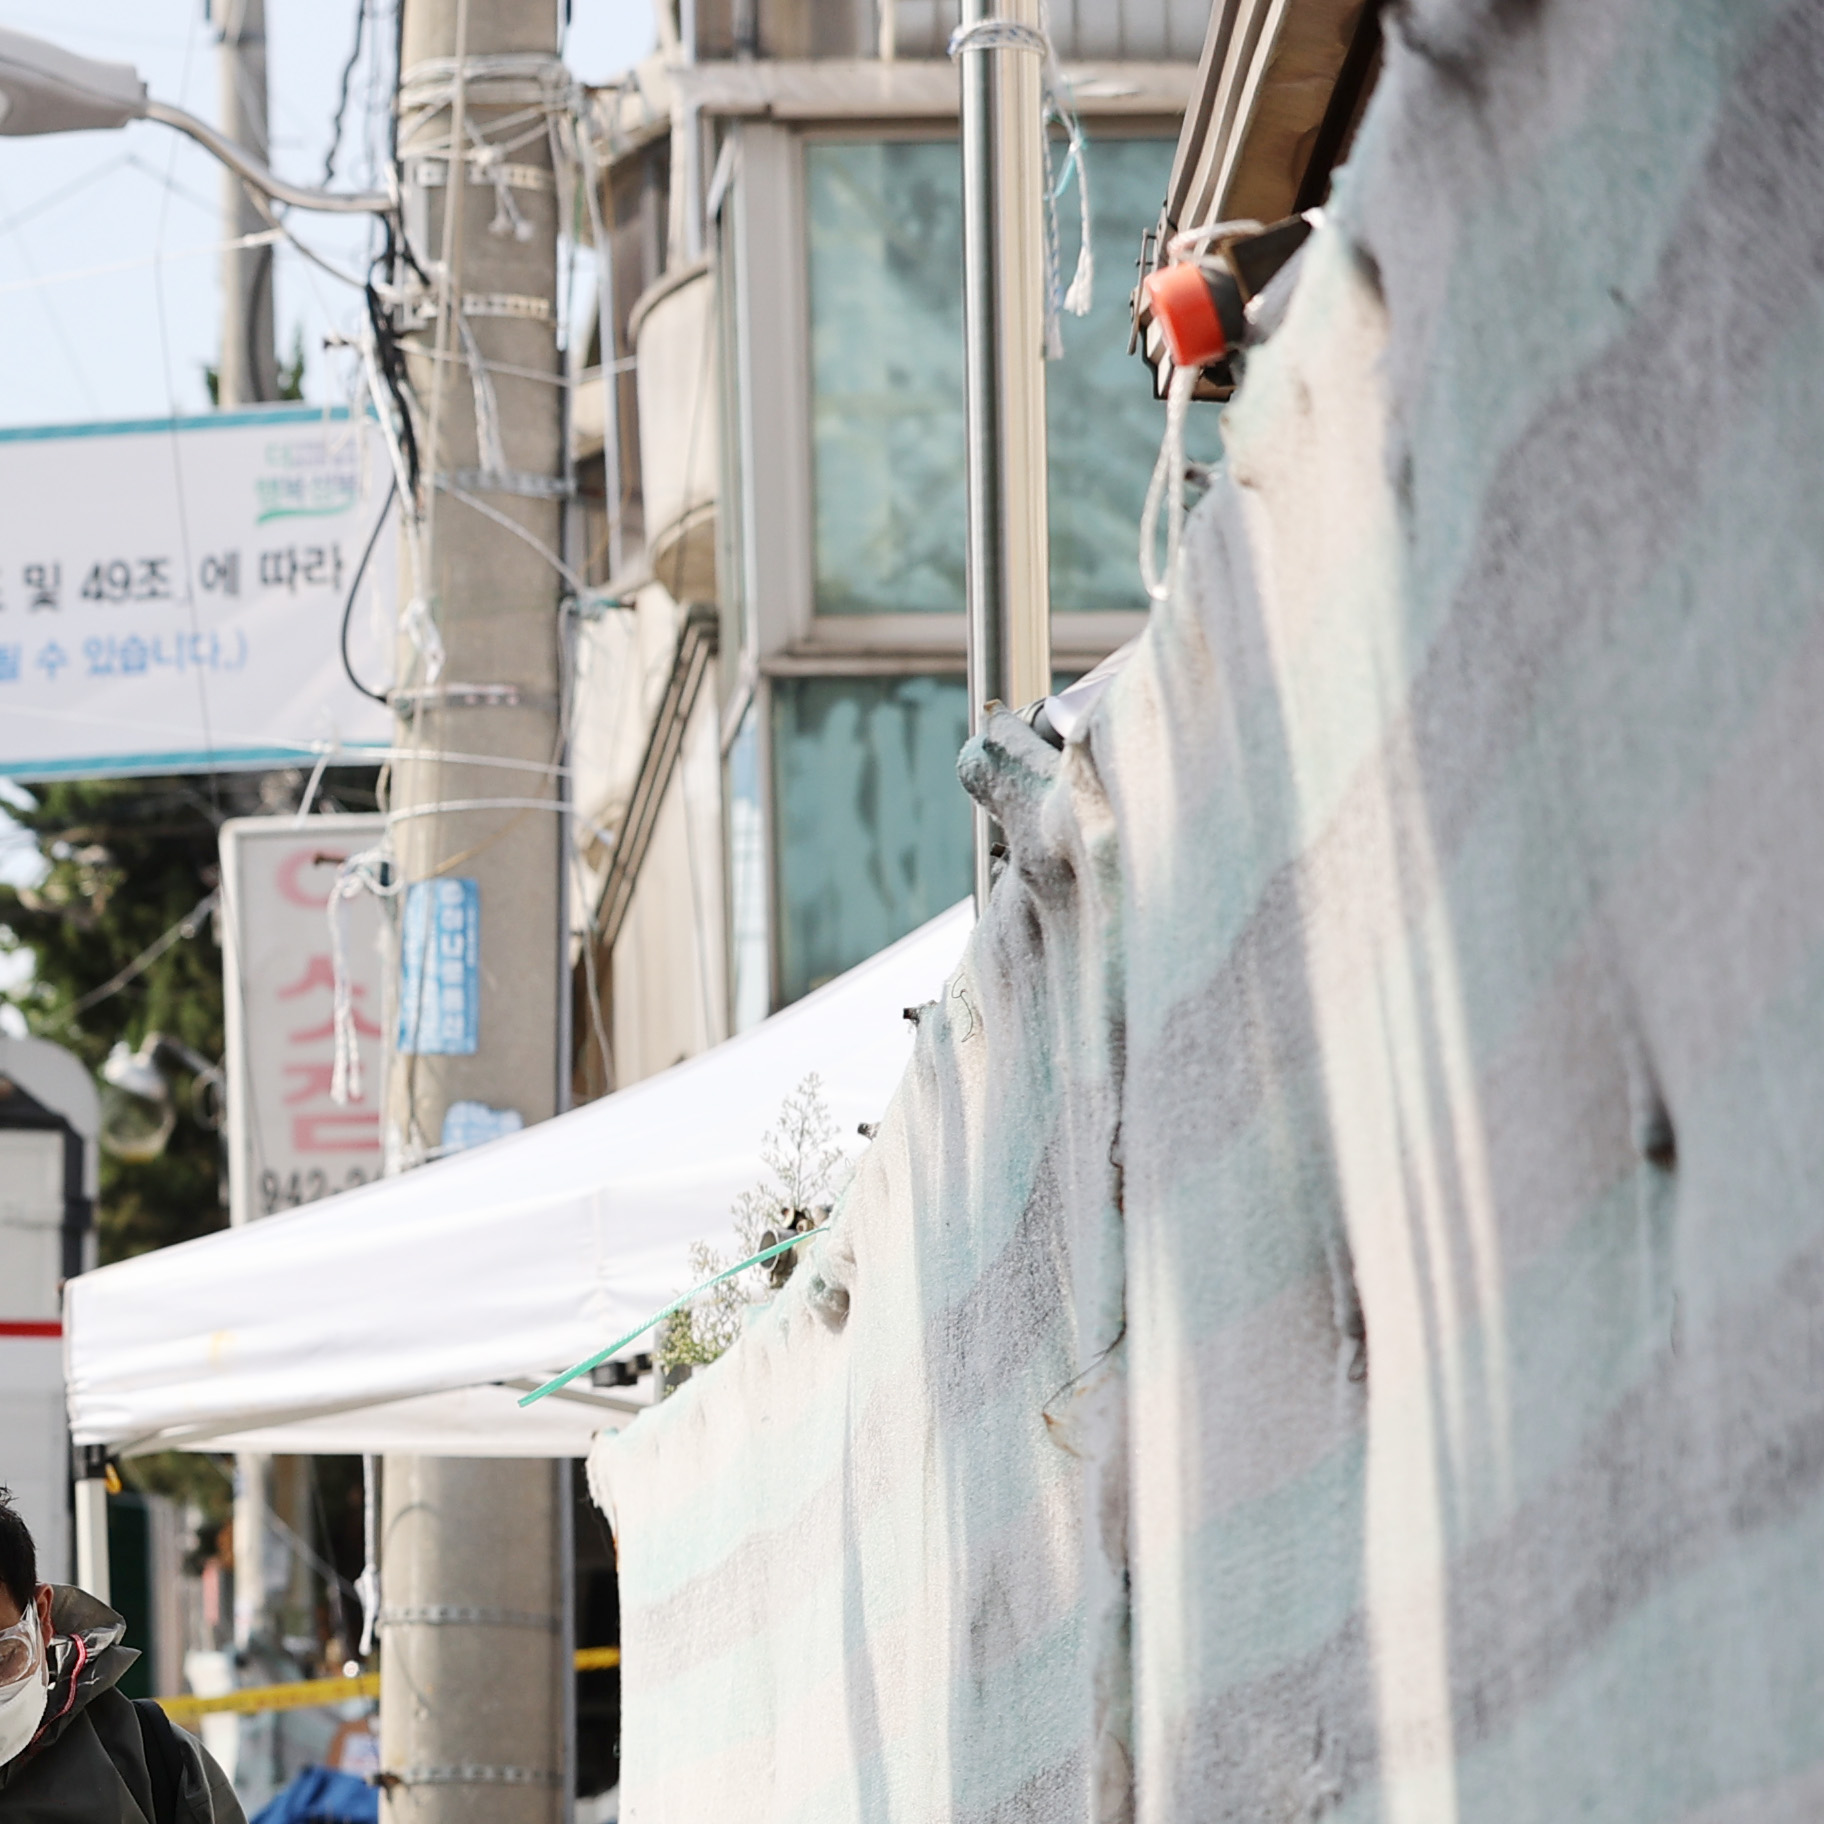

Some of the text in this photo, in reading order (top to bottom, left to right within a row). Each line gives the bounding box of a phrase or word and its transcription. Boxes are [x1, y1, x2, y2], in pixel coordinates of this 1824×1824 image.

[23, 560, 62, 615] 및
[259, 542, 344, 597] 따라
[36, 637, 68, 680] 수
